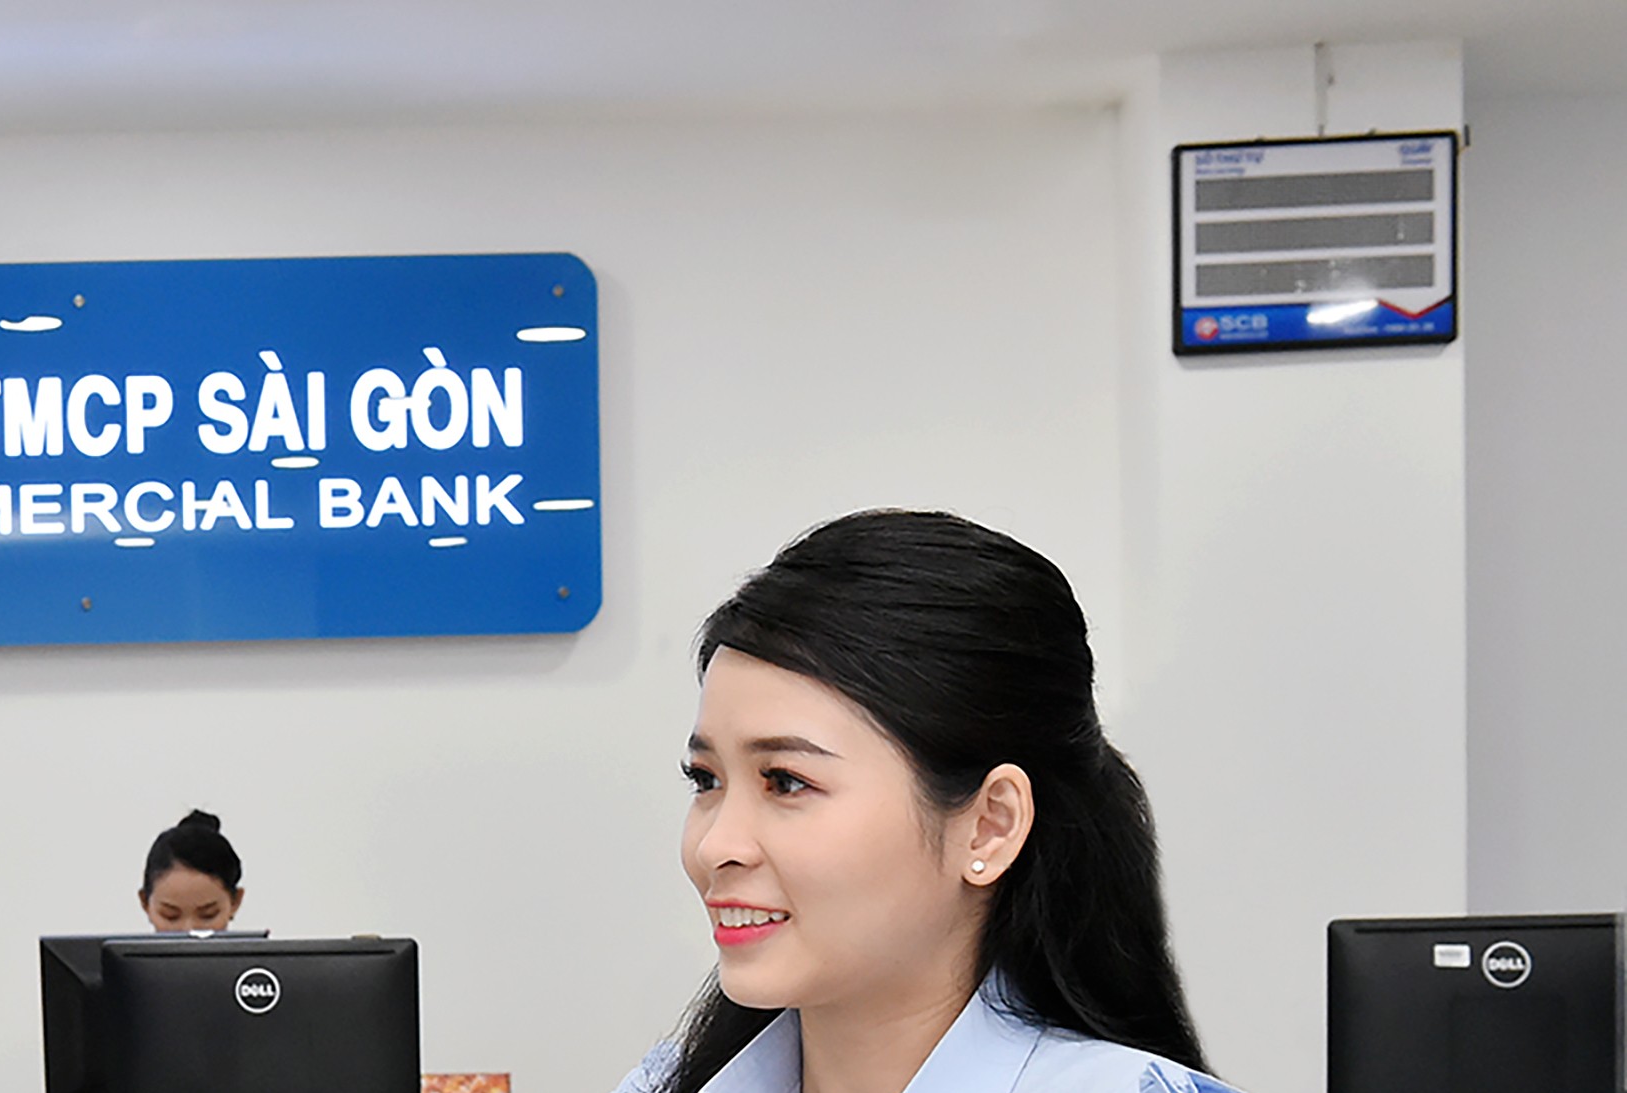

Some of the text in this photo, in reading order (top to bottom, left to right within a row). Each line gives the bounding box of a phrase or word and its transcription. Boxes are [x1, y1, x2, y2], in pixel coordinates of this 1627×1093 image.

[1220, 314, 1268, 331] SCB
[197, 350, 326, 454] SÀI
[351, 346, 524, 452] GÒN
[319, 473, 525, 530] BANK
[1488, 957, 1526, 971] DELL
[241, 983, 275, 998] DELL
